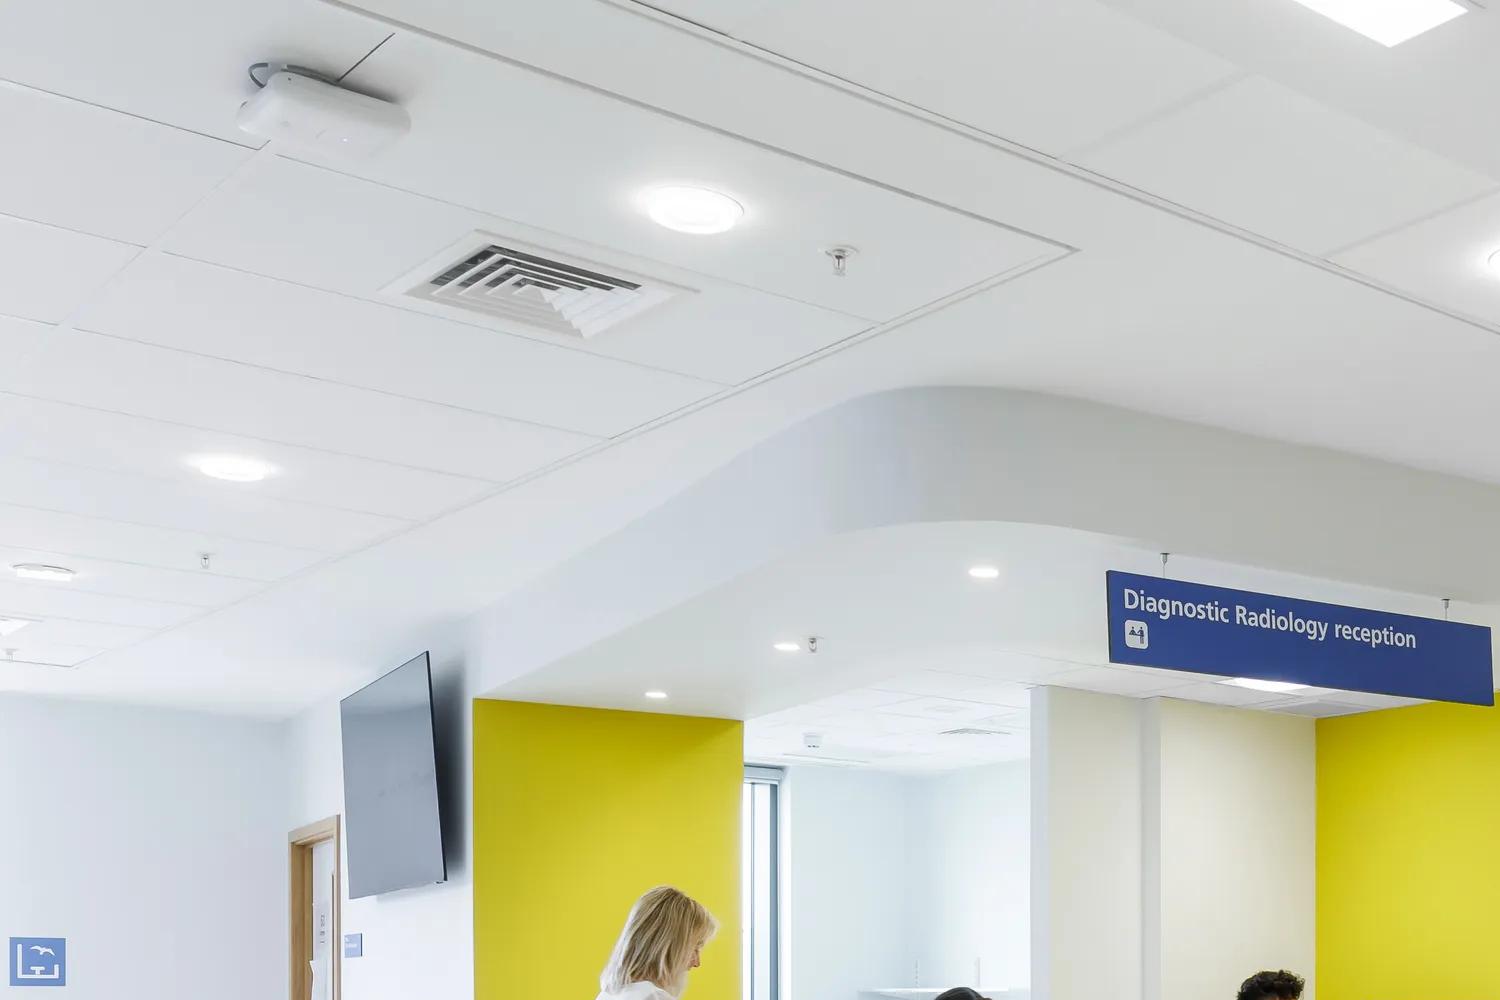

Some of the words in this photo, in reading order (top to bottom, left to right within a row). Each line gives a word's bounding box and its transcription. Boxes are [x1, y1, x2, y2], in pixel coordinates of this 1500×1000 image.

[1123, 588, 1229, 624] Diagnostic
[1235, 605, 1328, 642] Radiology
[1335, 622, 1417, 649] reception
